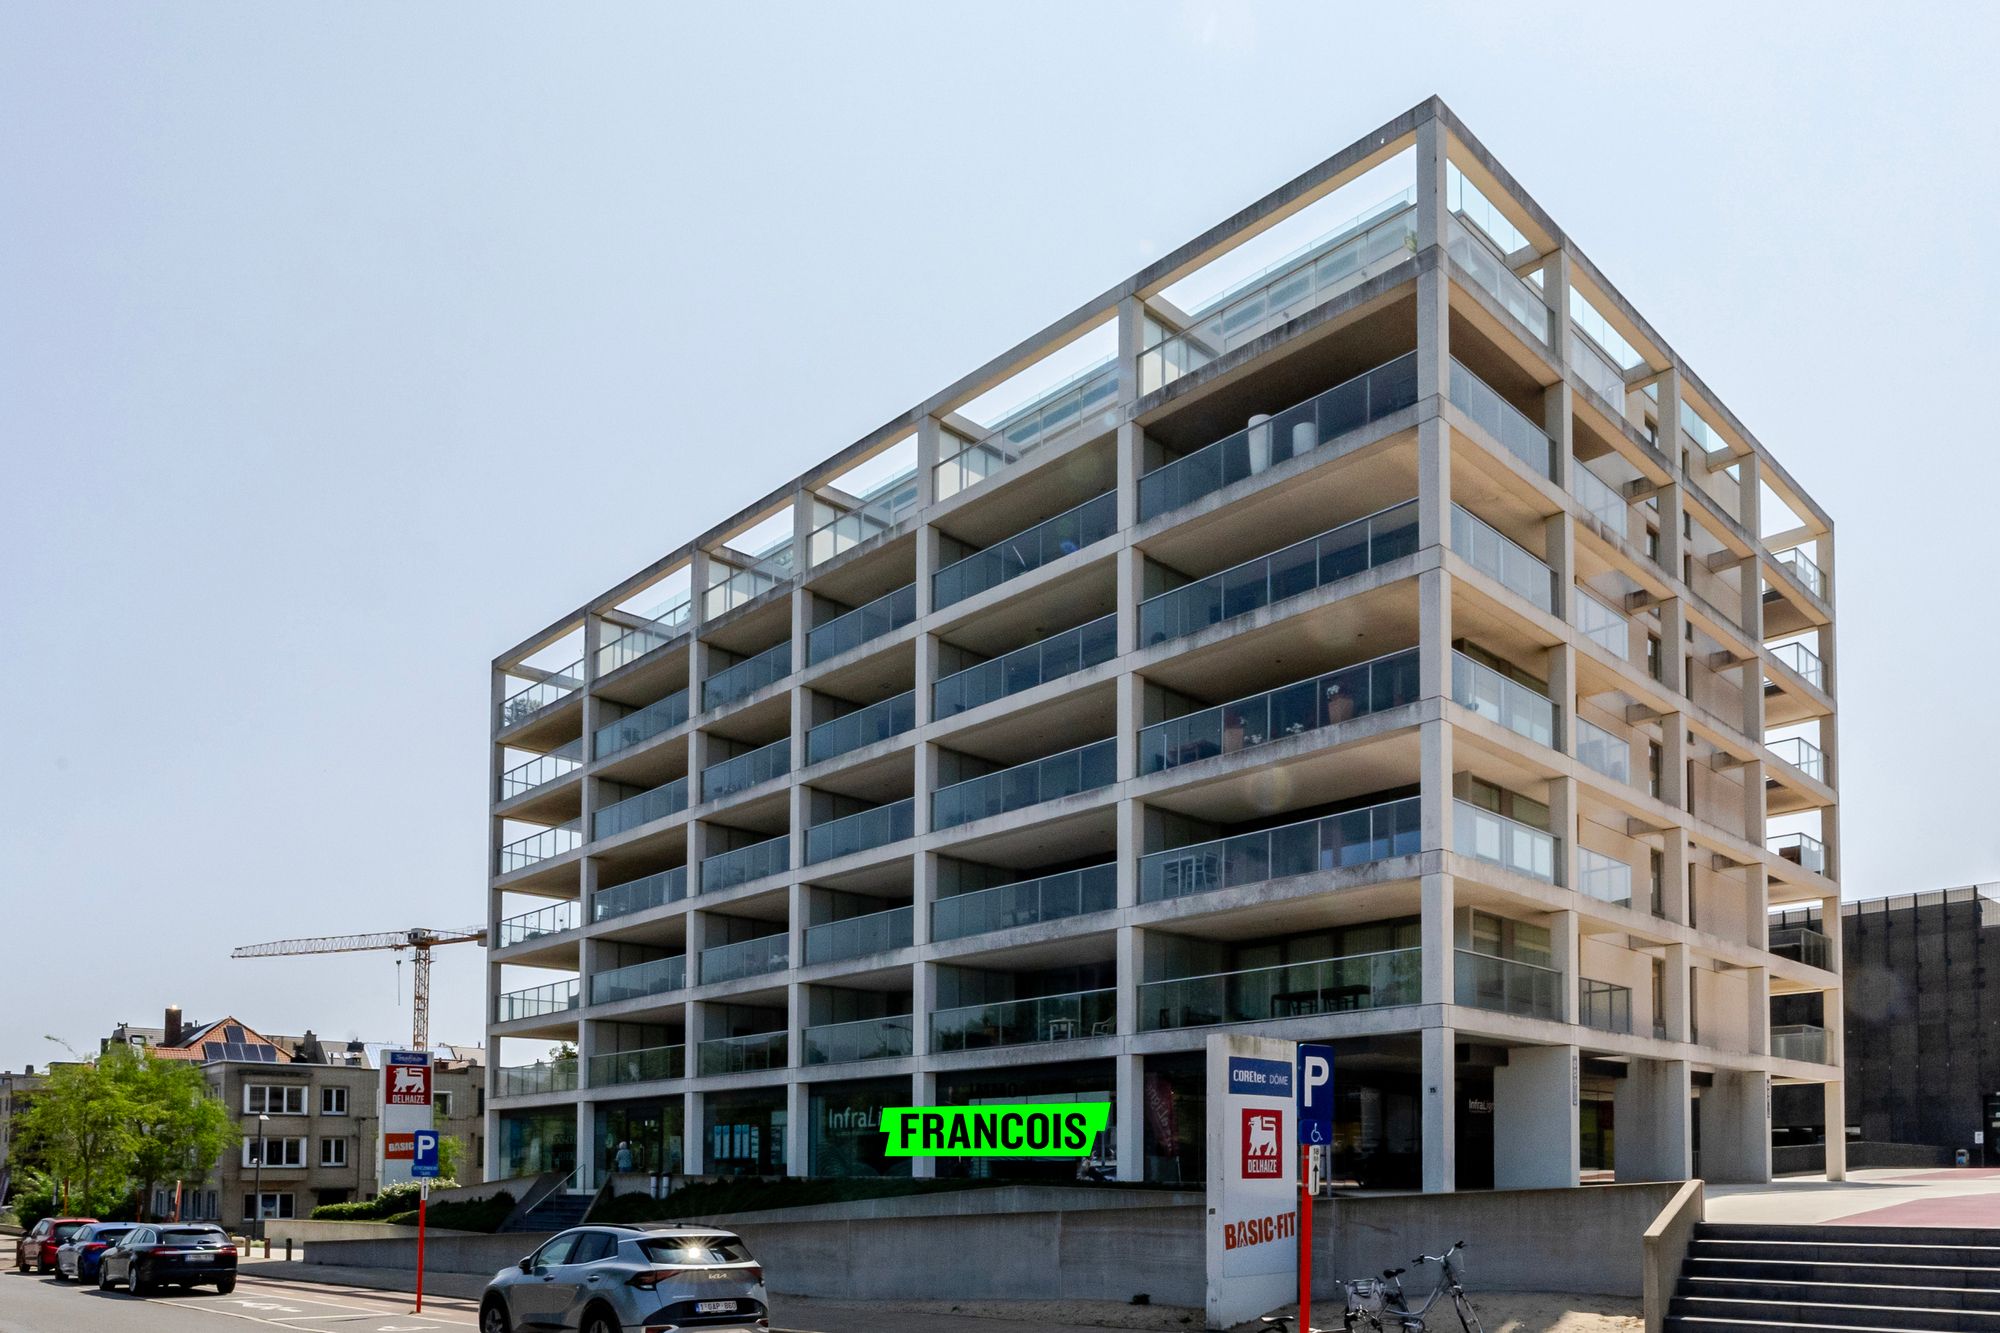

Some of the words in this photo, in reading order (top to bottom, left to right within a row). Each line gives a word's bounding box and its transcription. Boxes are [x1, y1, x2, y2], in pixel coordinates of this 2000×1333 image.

[1232, 1069, 1266, 1083] COREtec
[1304, 1056, 1330, 1107] P
[392, 1094, 425, 1104] DELHAIZE
[388, 1143, 414, 1152] BASIC
[417, 1135, 435, 1160] P
[1248, 1159, 1277, 1173] DELHAIZE
